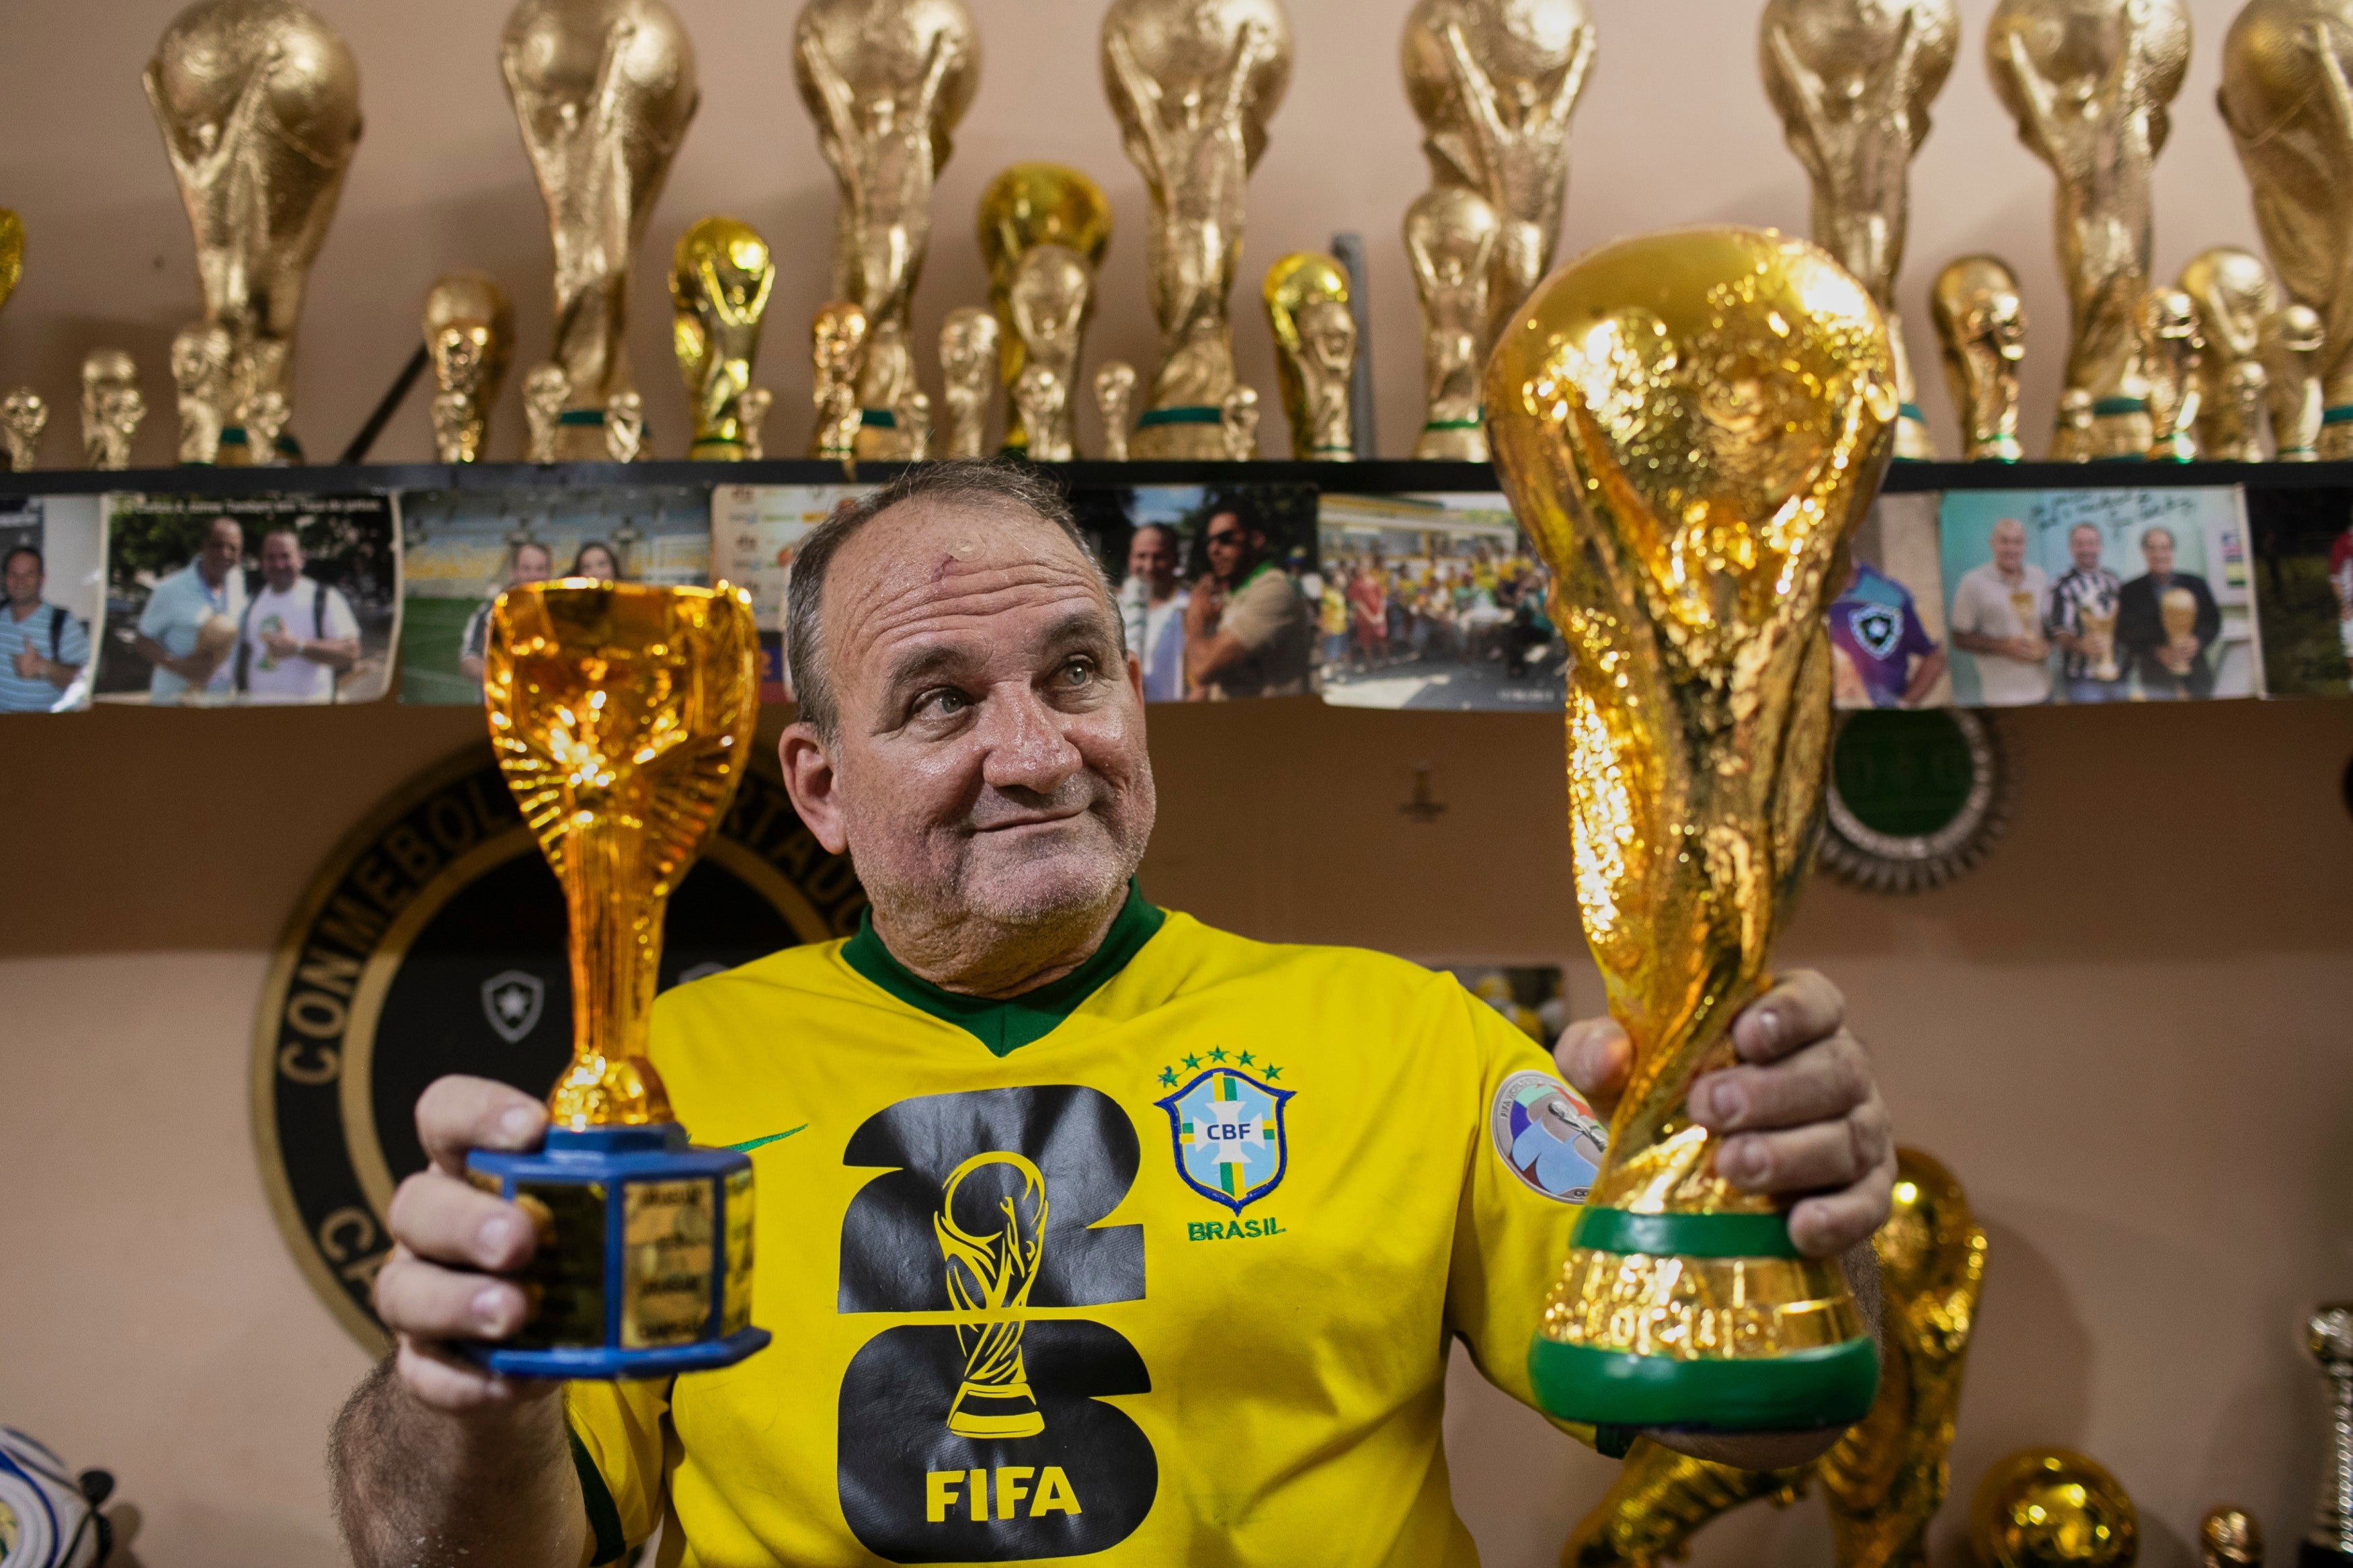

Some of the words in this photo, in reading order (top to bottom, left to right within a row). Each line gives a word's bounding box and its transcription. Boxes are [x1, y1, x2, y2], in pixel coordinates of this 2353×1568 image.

[279, 780, 512, 1084] CONMEBOL
[1207, 1123, 1251, 1141] CBF
[1187, 1217, 1287, 1241] BRASIL
[926, 1466, 1082, 1522] FIFA
